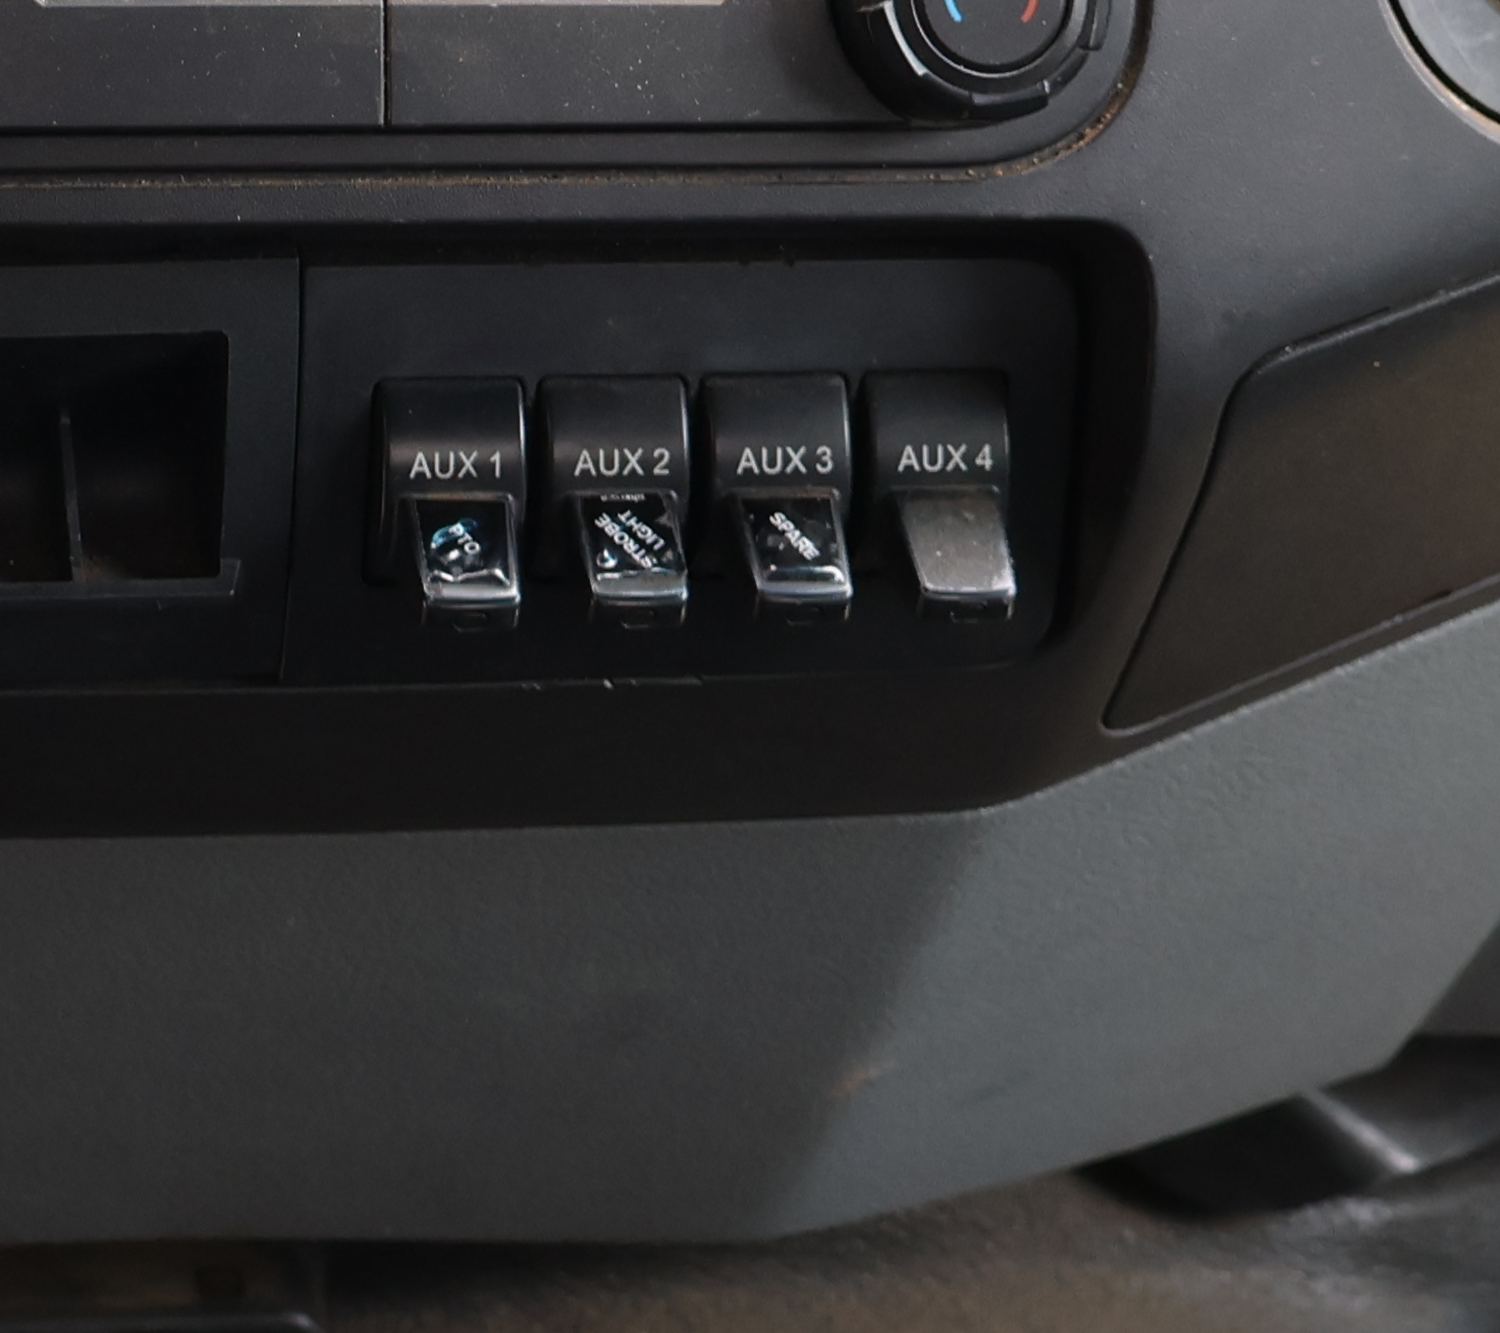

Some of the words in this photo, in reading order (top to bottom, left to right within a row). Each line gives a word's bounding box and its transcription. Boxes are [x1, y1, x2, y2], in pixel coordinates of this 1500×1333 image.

[410, 451, 481, 481] AUX
[490, 451, 502, 477] 1
[574, 448, 645, 477] AUX
[653, 447, 670, 475] 2
[737, 447, 807, 475] AUX
[816, 446, 834, 473] 3
[898, 444, 967, 473] AUX
[974, 443, 993, 471] 4
[617, 510, 665, 551] LIGHT
[768, 511, 820, 561] SPARE
